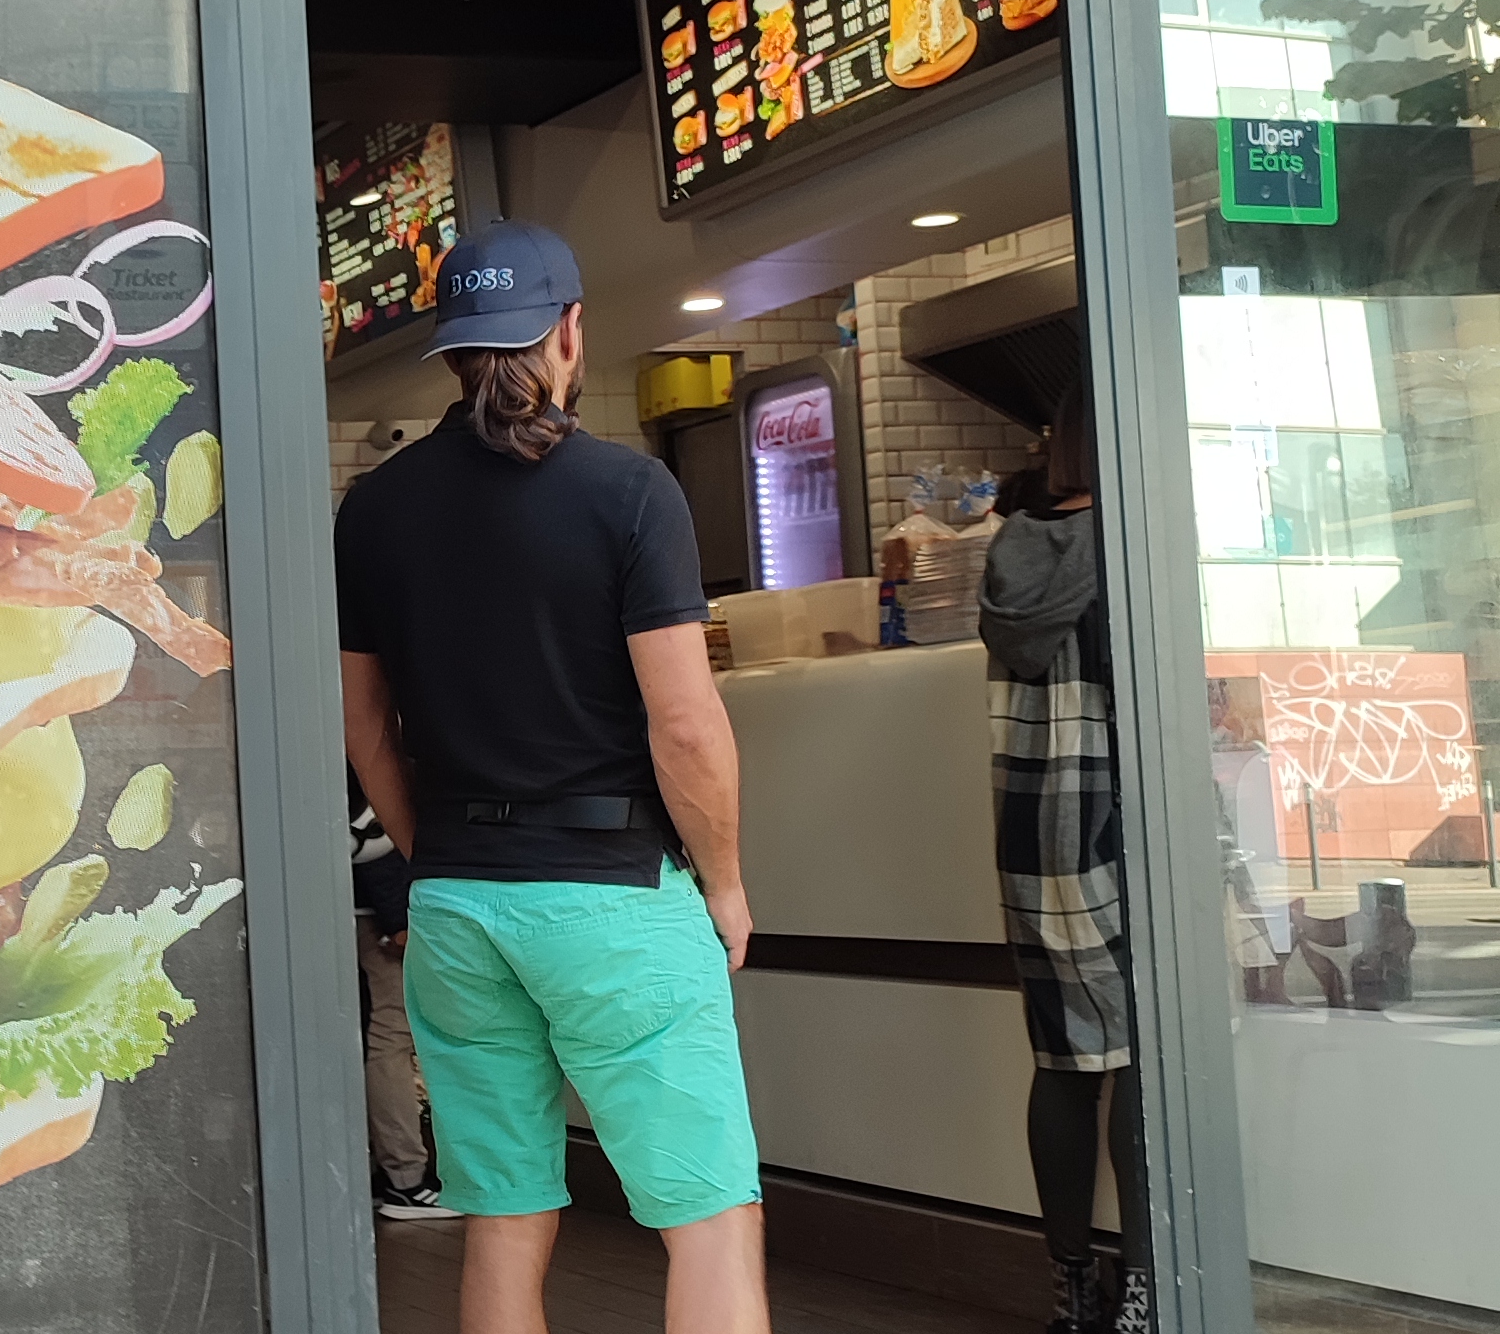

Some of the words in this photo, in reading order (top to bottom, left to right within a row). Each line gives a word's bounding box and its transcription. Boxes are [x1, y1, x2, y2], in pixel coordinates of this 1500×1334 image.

[1246, 122, 1304, 148] Uber
[1249, 149, 1305, 173] Eats
[450, 267, 514, 298] BOSS
